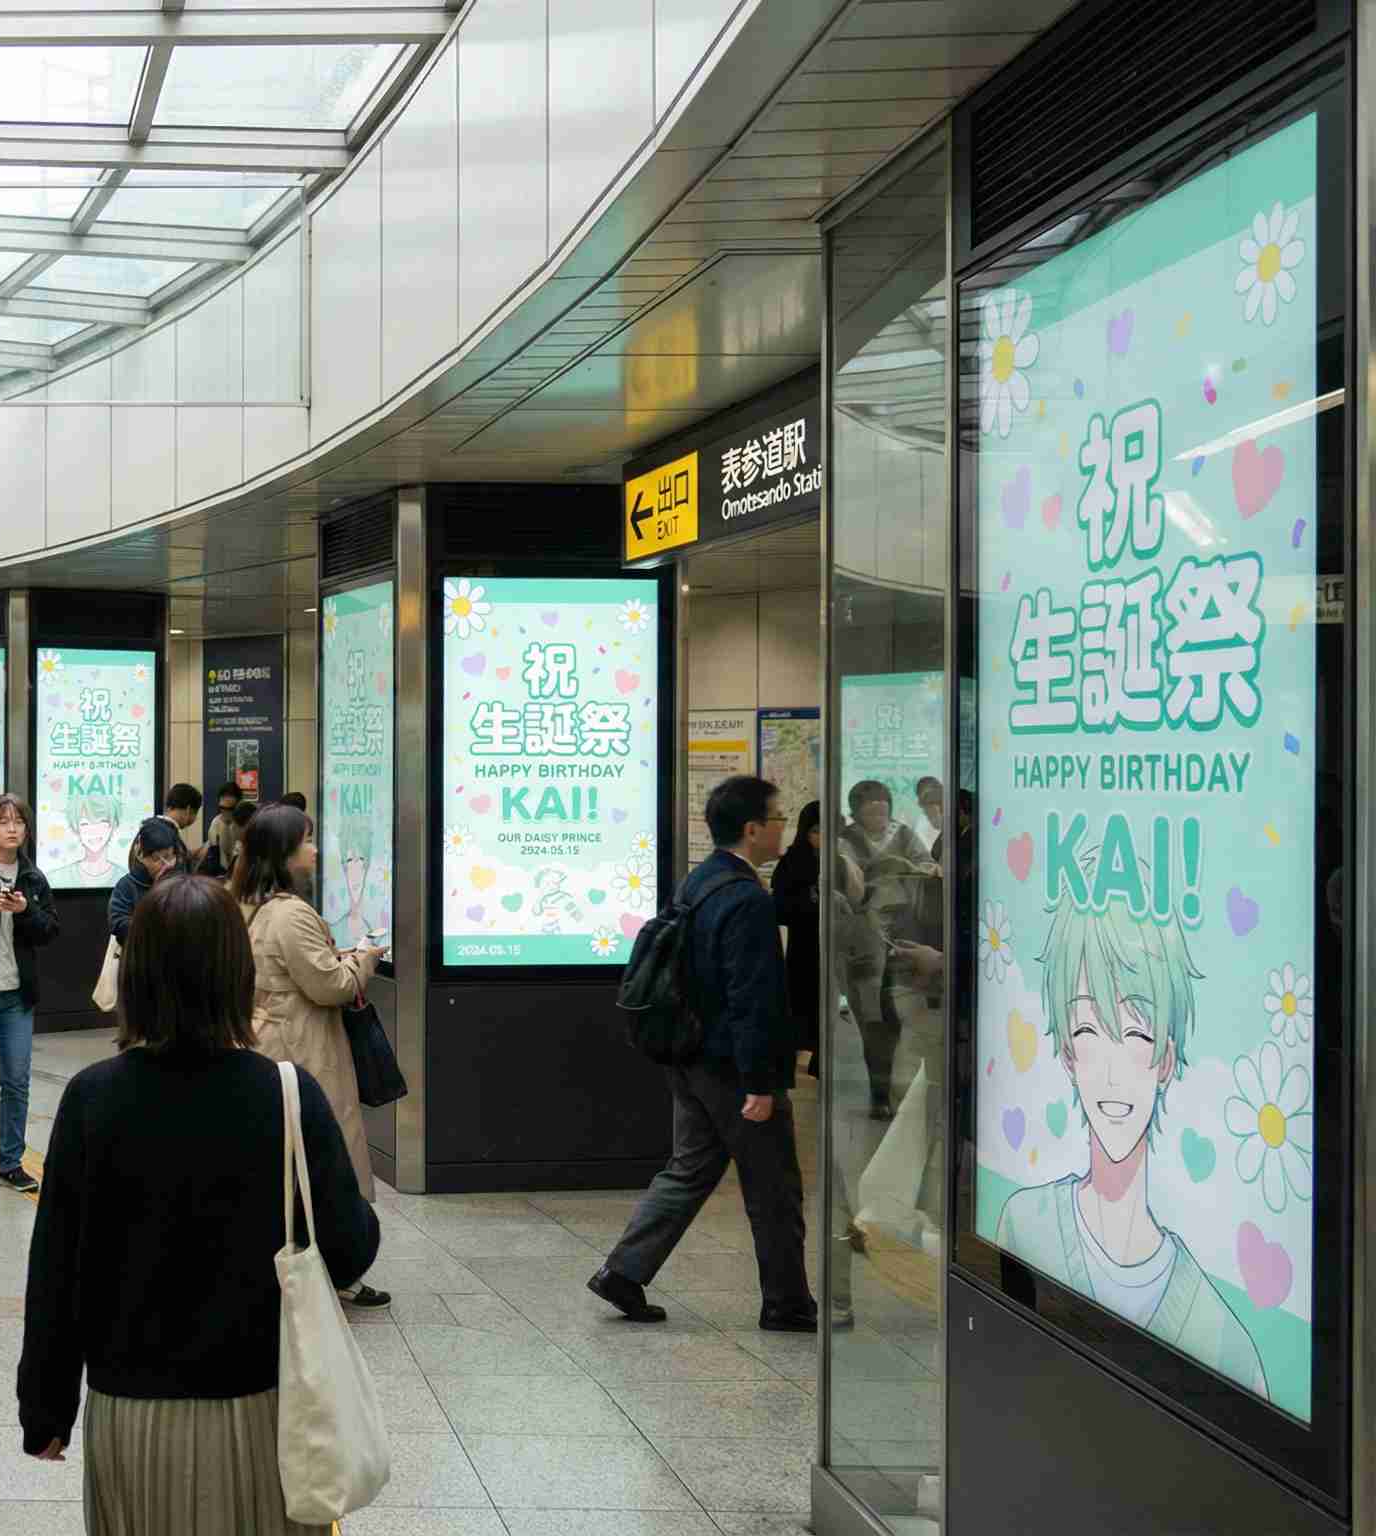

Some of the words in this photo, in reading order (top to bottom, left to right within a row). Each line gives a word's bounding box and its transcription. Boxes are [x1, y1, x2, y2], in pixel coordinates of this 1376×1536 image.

[720, 418, 806, 494] 表参道駅
[657, 470, 689, 514] 出口
[721, 477, 792, 520] Omotesando
[1077, 397, 1166, 572] 祝
[657, 515, 680, 539] EXIT
[1008, 550, 1267, 736] 生誕祭
[522, 641, 580, 699] 祝
[80, 687, 112, 722] 祝
[49, 721, 141, 757] 生誕祭
[470, 700, 632, 757] 生誕祭
[68, 773, 124, 796] KAI!
[474, 764, 532, 778] HAPPY
[538, 764, 625, 778] BIRTHDAY
[1013, 754, 1091, 790] HAPPY
[1099, 752, 1252, 794] BIRTHDAY
[500, 785, 599, 823] KAI!
[497, 832, 521, 843] OUR
[525, 832, 559, 843] DAISY
[562, 832, 602, 843] PRINCE
[1042, 809, 1206, 931] KAI!
